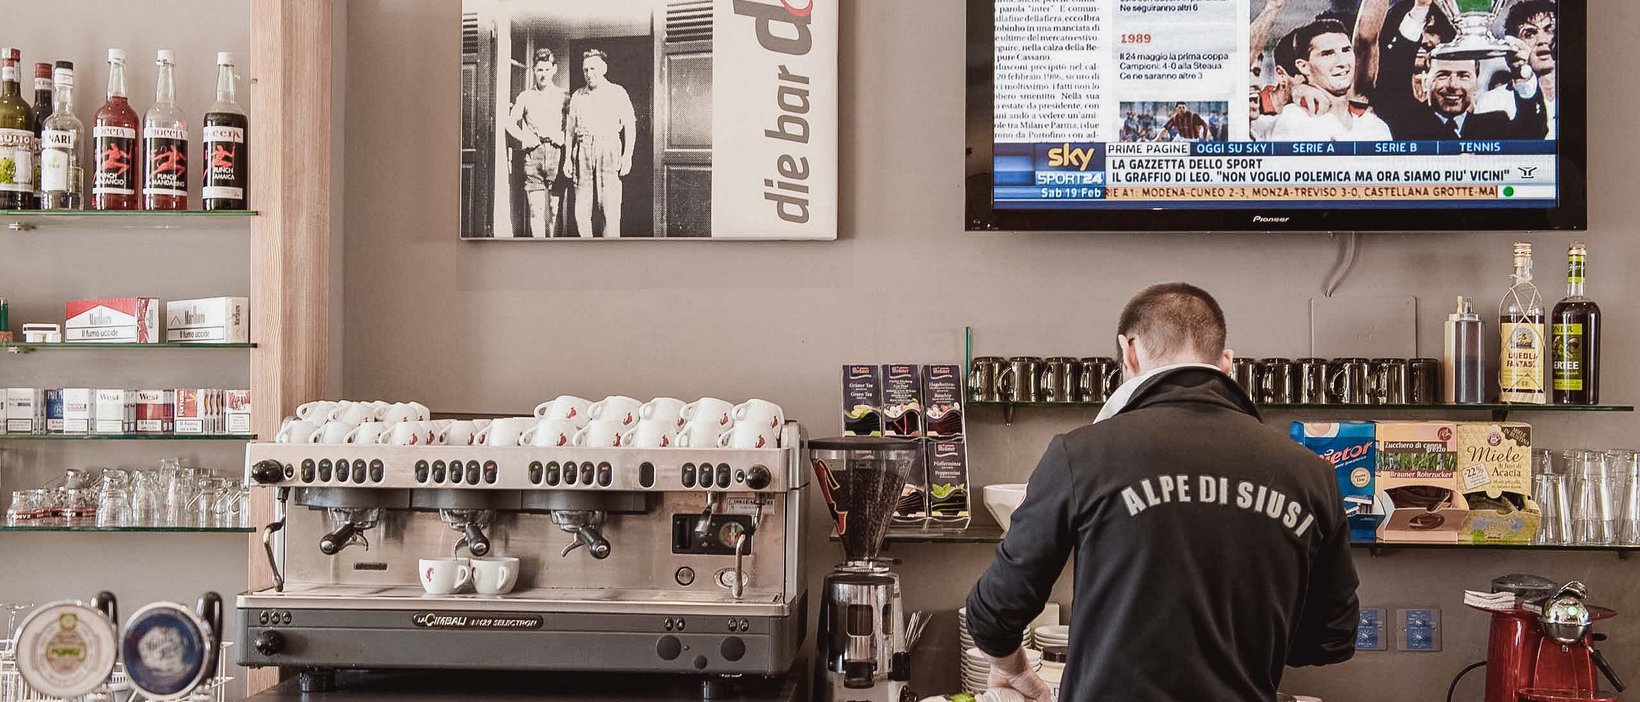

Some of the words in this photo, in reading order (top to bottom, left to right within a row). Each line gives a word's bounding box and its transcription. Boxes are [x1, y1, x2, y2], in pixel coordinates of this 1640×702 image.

[1000, 5, 1025, 14] parola
[1132, 5, 1176, 13] seguiranno
[1121, 33, 1152, 44] 1989
[1137, 53, 1168, 62] maggio
[1178, 53, 1201, 62] prima
[1202, 54, 1229, 62] coppa
[764, 64, 810, 144] bar
[0, 135, 31, 145] ULIO
[1028, 131, 1066, 139] Portofino
[1108, 144, 1142, 154] PRIME
[1146, 144, 1188, 154] PAGINE
[1196, 143, 1225, 154] OGGI
[1228, 143, 1243, 153] SU
[1246, 143, 1267, 153] SKY
[1292, 143, 1323, 153] SERIE
[1326, 143, 1335, 153] A
[1374, 143, 1407, 153] SERIE
[1410, 143, 1418, 153] B
[1459, 142, 1501, 152] TENNIS
[1047, 143, 1094, 171] sky
[1112, 159, 1126, 170] LA
[1129, 159, 1186, 170] GAZZETTA
[1189, 159, 1223, 170] DELLO
[1226, 158, 1263, 169] SPORT
[156, 173, 177, 181] PUNCH
[1037, 172, 1104, 186] SPORT24
[1112, 172, 1122, 182] IL
[1125, 172, 1172, 182] GRAFFIO
[1175, 172, 1186, 182] DI
[1190, 172, 1214, 183] LEO.
[1217, 171, 1246, 182] "NON
[1250, 171, 1290, 182] VOGLIO
[1294, 171, 1351, 182] POLEMICA
[1355, 171, 1373, 182] MA
[1376, 171, 1399, 182] ORA
[1403, 171, 1442, 182] SIAMO
[1445, 170, 1466, 181] PIU'
[1470, 169, 1510, 181] VICINI"
[764, 154, 810, 224] die
[1041, 187, 1062, 198] Sab
[1065, 187, 1077, 198] 19
[1080, 187, 1102, 198] Feb
[1122, 188, 1138, 198] A1:
[1142, 188, 1225, 198] MODENA-CUNEO
[1229, 187, 1249, 199] 2-3,
[1252, 187, 1337, 197] MONZA-TREVISO
[1341, 187, 1361, 198] 3-0,
[1364, 187, 1430, 197] CASTELLANA
[1252, 215, 1290, 223] Pioneer
[87, 329, 100, 338] fumo
[100, 328, 119, 337] uccide
[183, 331, 195, 339] fumo
[195, 330, 210, 338] uccide
[139, 393, 159, 401] West
[1384, 442, 1413, 450] Zucchero
[1414, 442, 1421, 450] di
[1466, 446, 1523, 462] Miele
[1491, 466, 1522, 477] Acacia
[1120, 474, 1191, 517] ALPE
[1199, 475, 1228, 505] DI
[1236, 480, 1315, 538] SIUSI
[425, 613, 468, 627] CIMBALI
